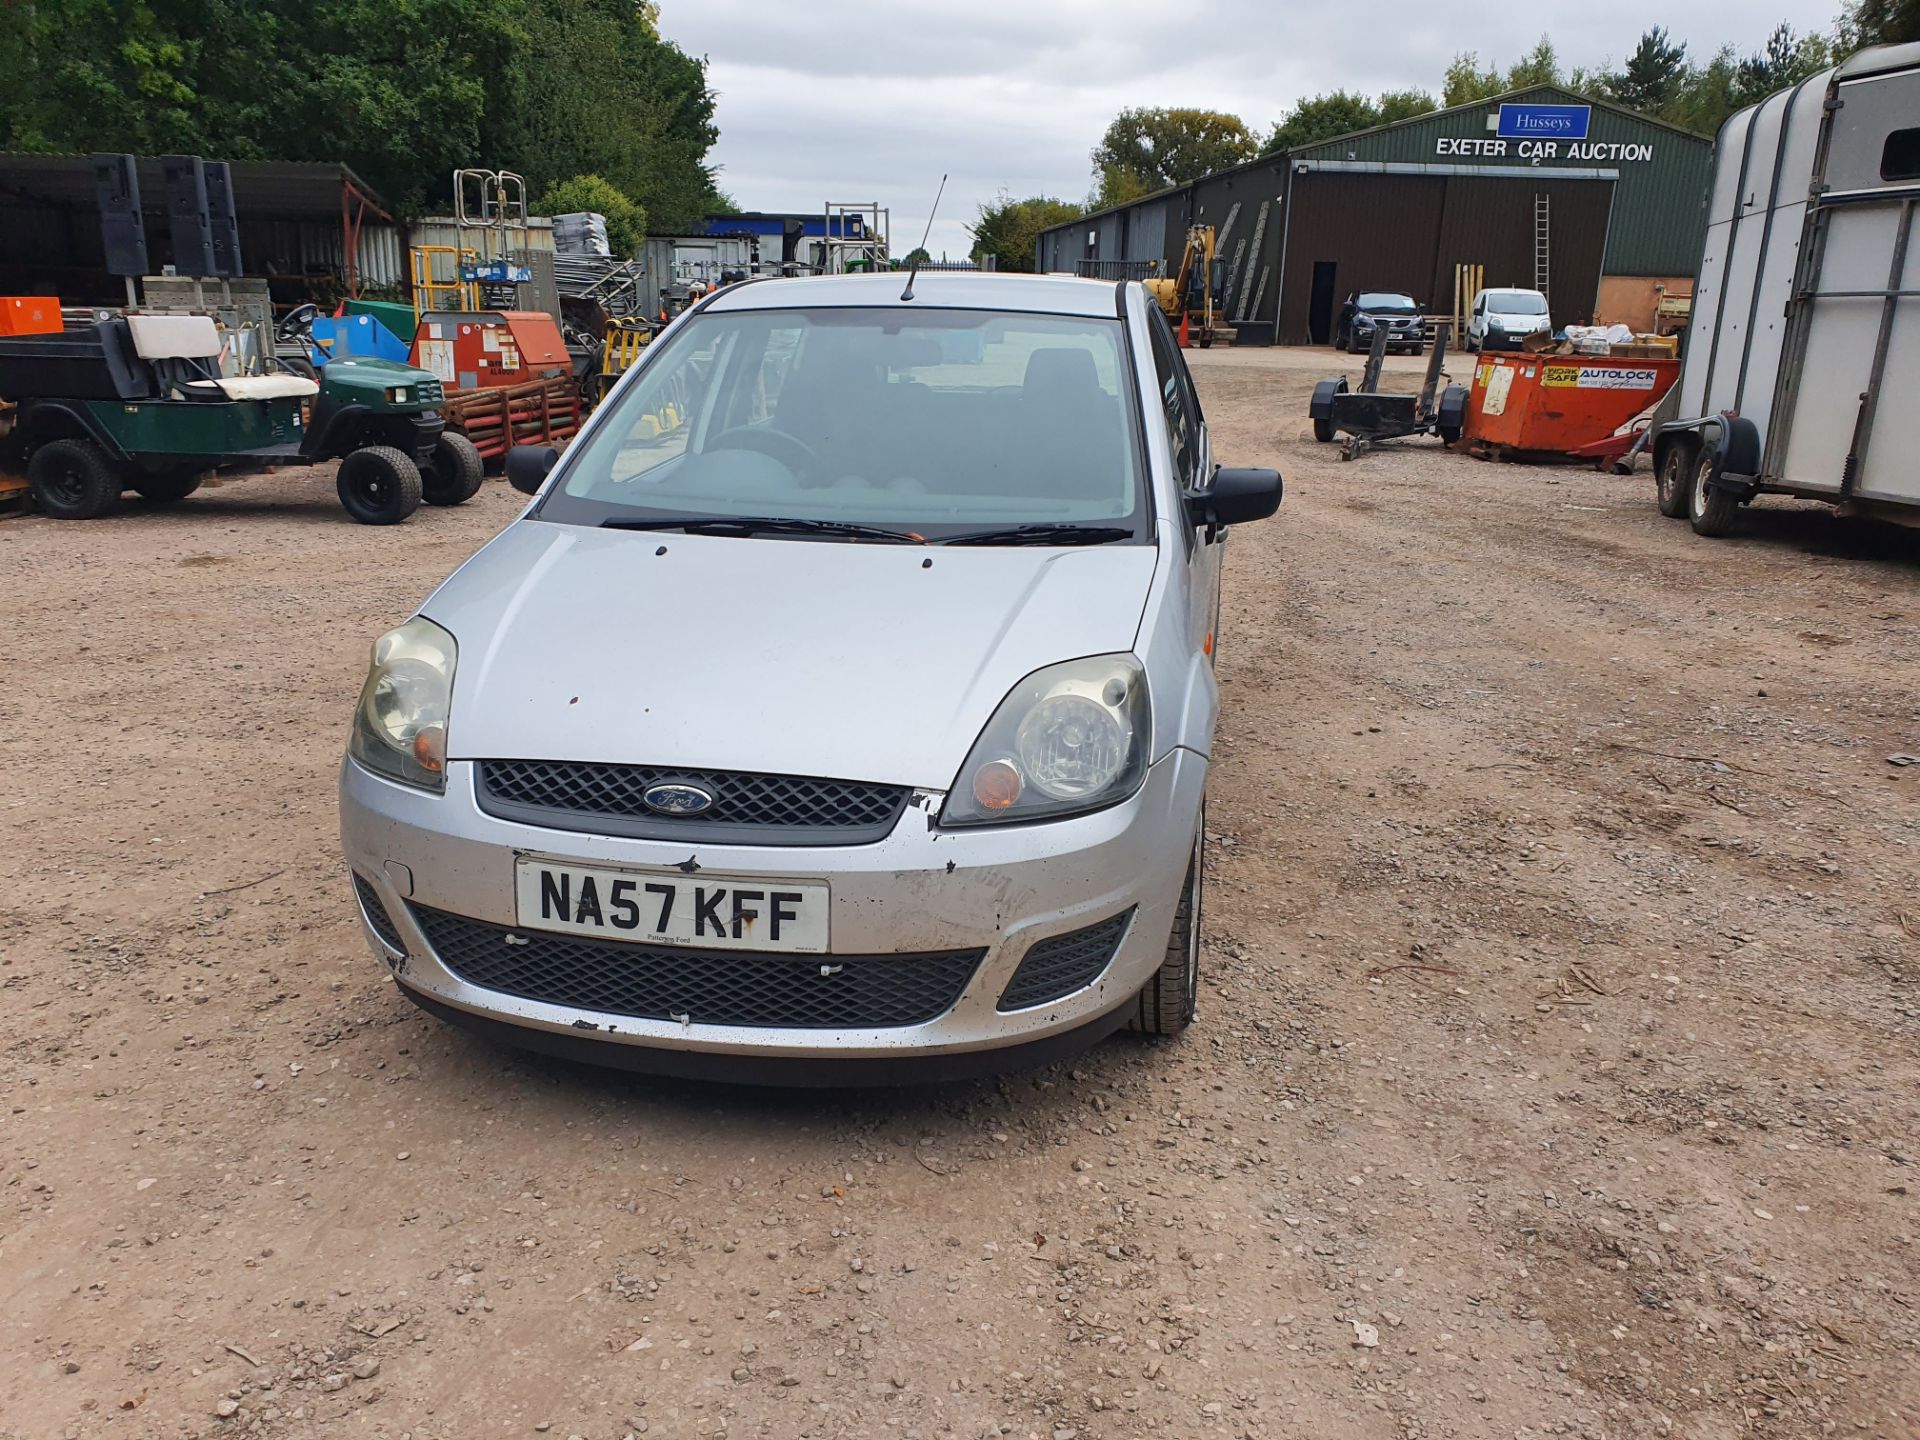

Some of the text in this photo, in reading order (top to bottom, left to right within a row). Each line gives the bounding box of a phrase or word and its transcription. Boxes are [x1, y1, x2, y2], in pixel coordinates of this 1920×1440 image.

[1516, 113, 1572, 131] Husseys
[1436, 138, 1653, 161] EXETER CAR AUCTION
[1580, 369, 1655, 380] AUTOLOCK
[541, 870, 803, 941] NA57 KFF
